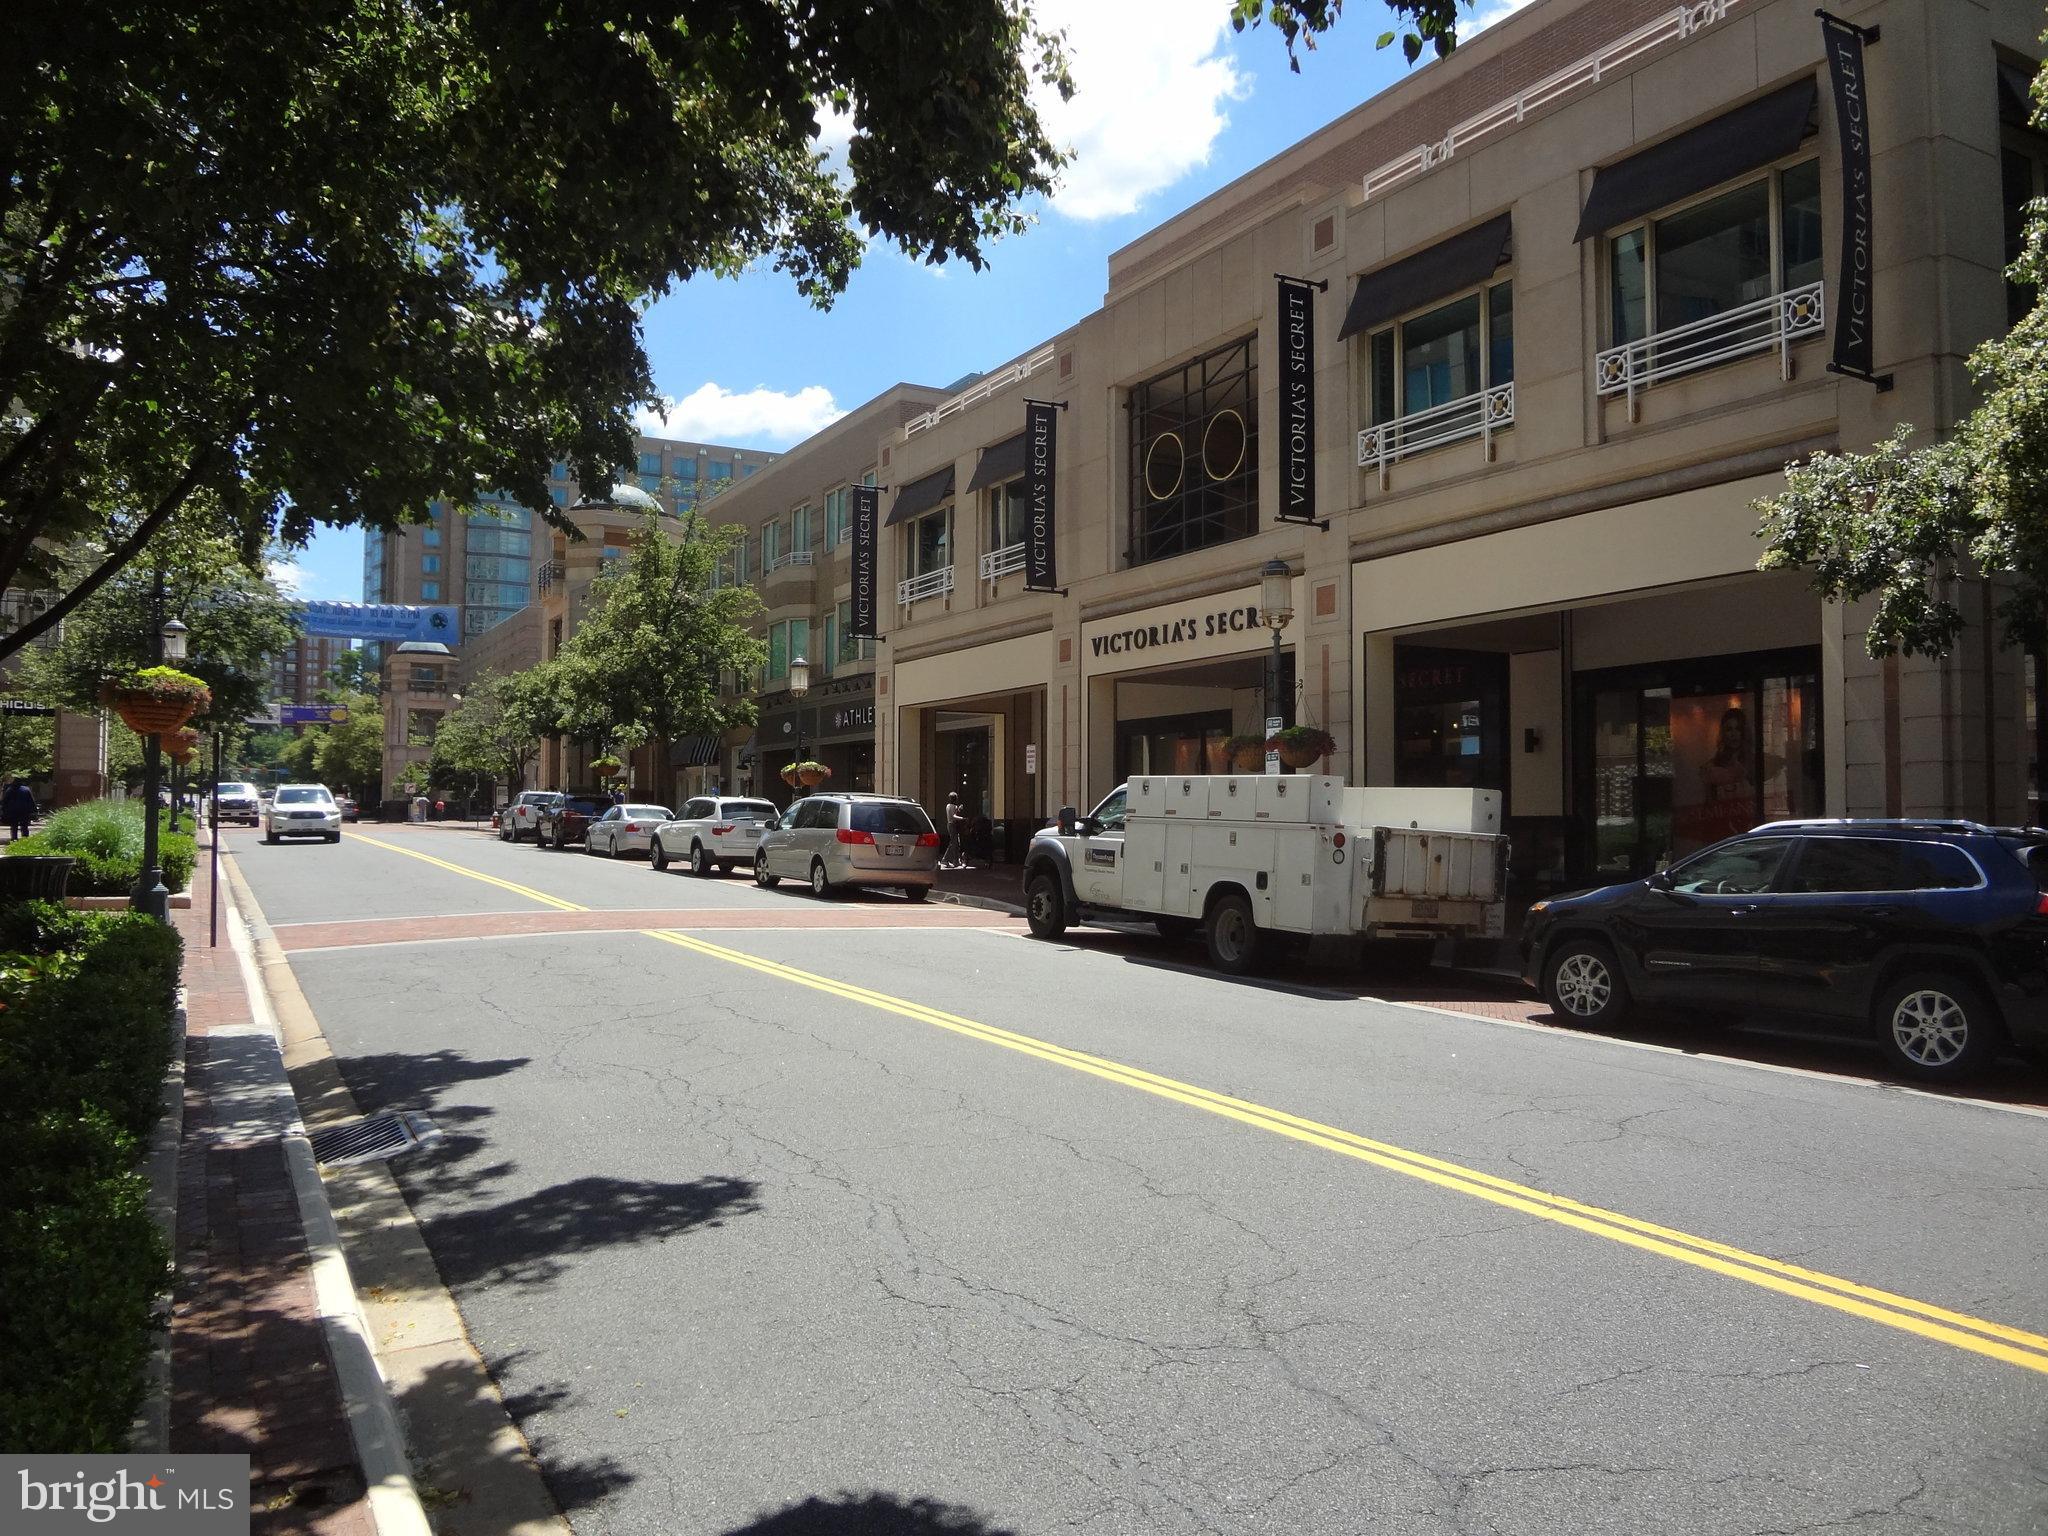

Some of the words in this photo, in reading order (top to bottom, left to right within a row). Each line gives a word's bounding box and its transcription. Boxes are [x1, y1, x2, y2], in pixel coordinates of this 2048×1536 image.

[1837, 42, 1864, 155] SECRET
[1848, 168, 1866, 349] VICTORIA'S
[1290, 293, 1305, 373] SECRET
[1035, 413, 1047, 476] SECRET
[1290, 382, 1306, 506] VICTORIA'S
[860, 496, 871, 546] SECRET
[1033, 483, 1047, 578] VICTORIA'S
[858, 552, 869, 628] VICTORIA'S
[1091, 619, 1197, 657] VICTORIA'S
[843, 706, 875, 726] ATHLE
